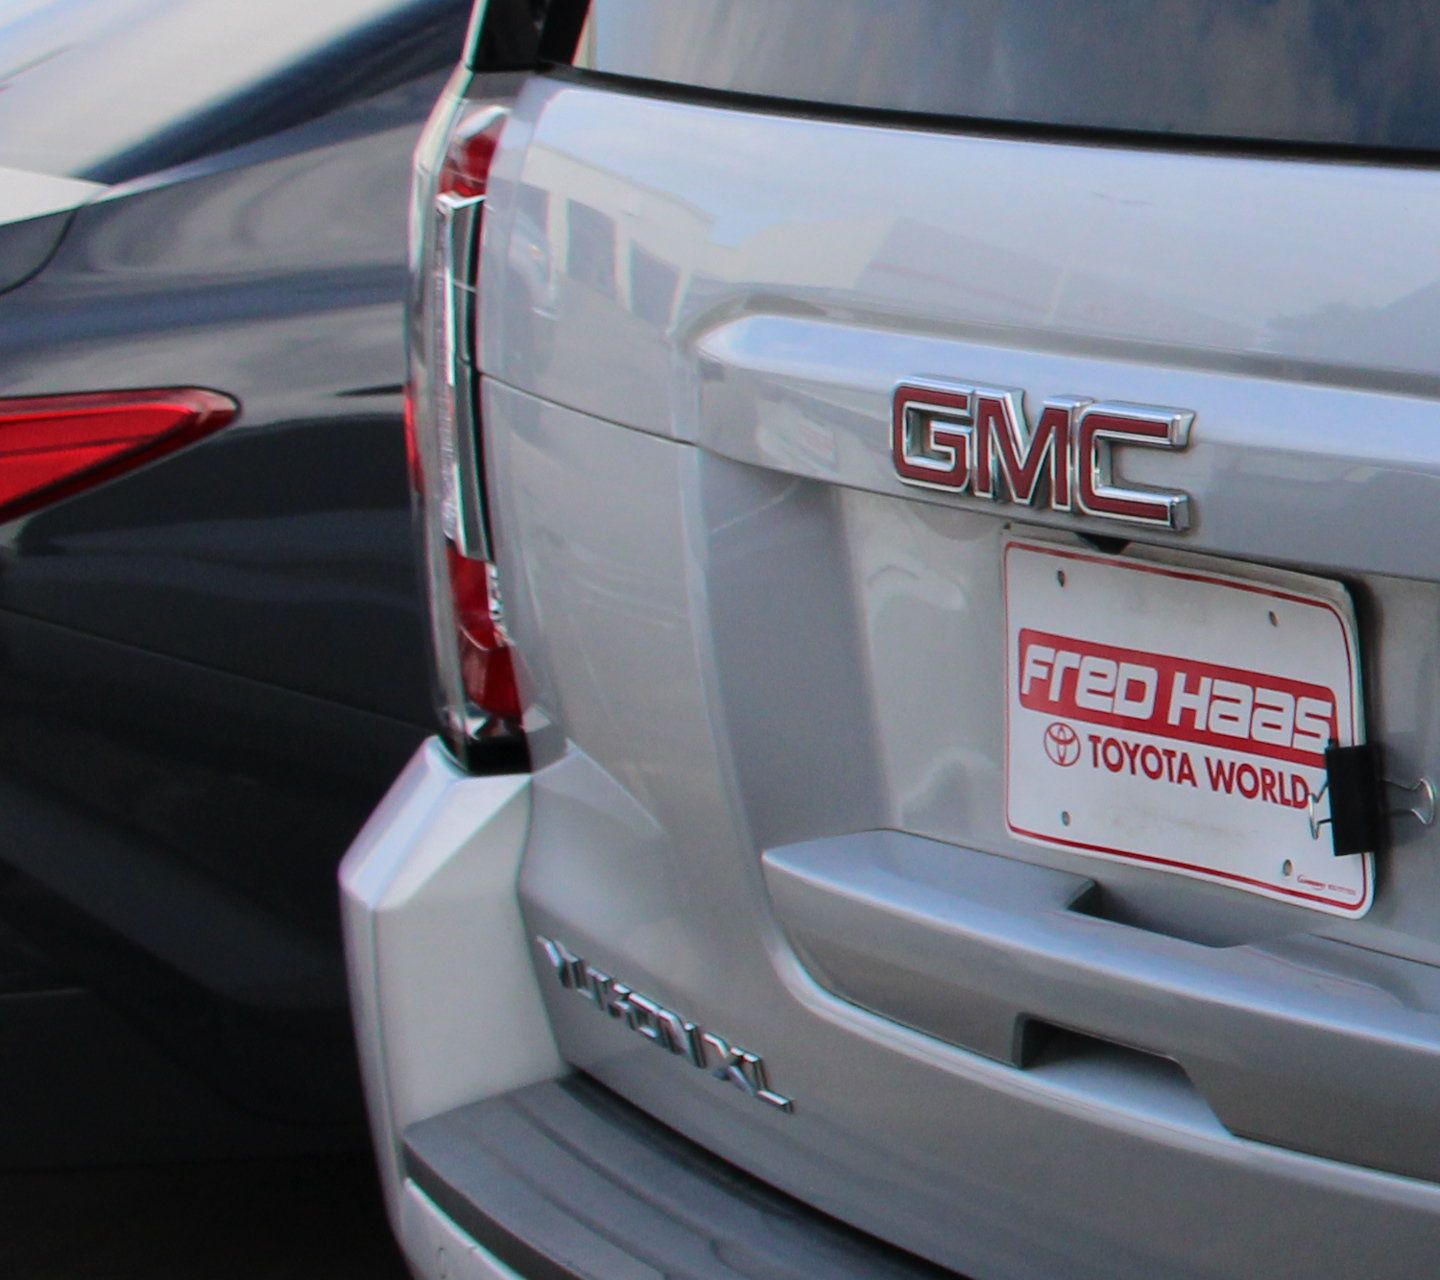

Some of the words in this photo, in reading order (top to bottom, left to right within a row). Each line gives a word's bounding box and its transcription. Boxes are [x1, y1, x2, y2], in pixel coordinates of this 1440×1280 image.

[889, 374, 1197, 531] GMC
[1087, 733, 1197, 790] TOYOTA
[1203, 755, 1310, 810] WORLD
[535, 933, 709, 1069] YUKON
[702, 1031, 797, 1115] XL
